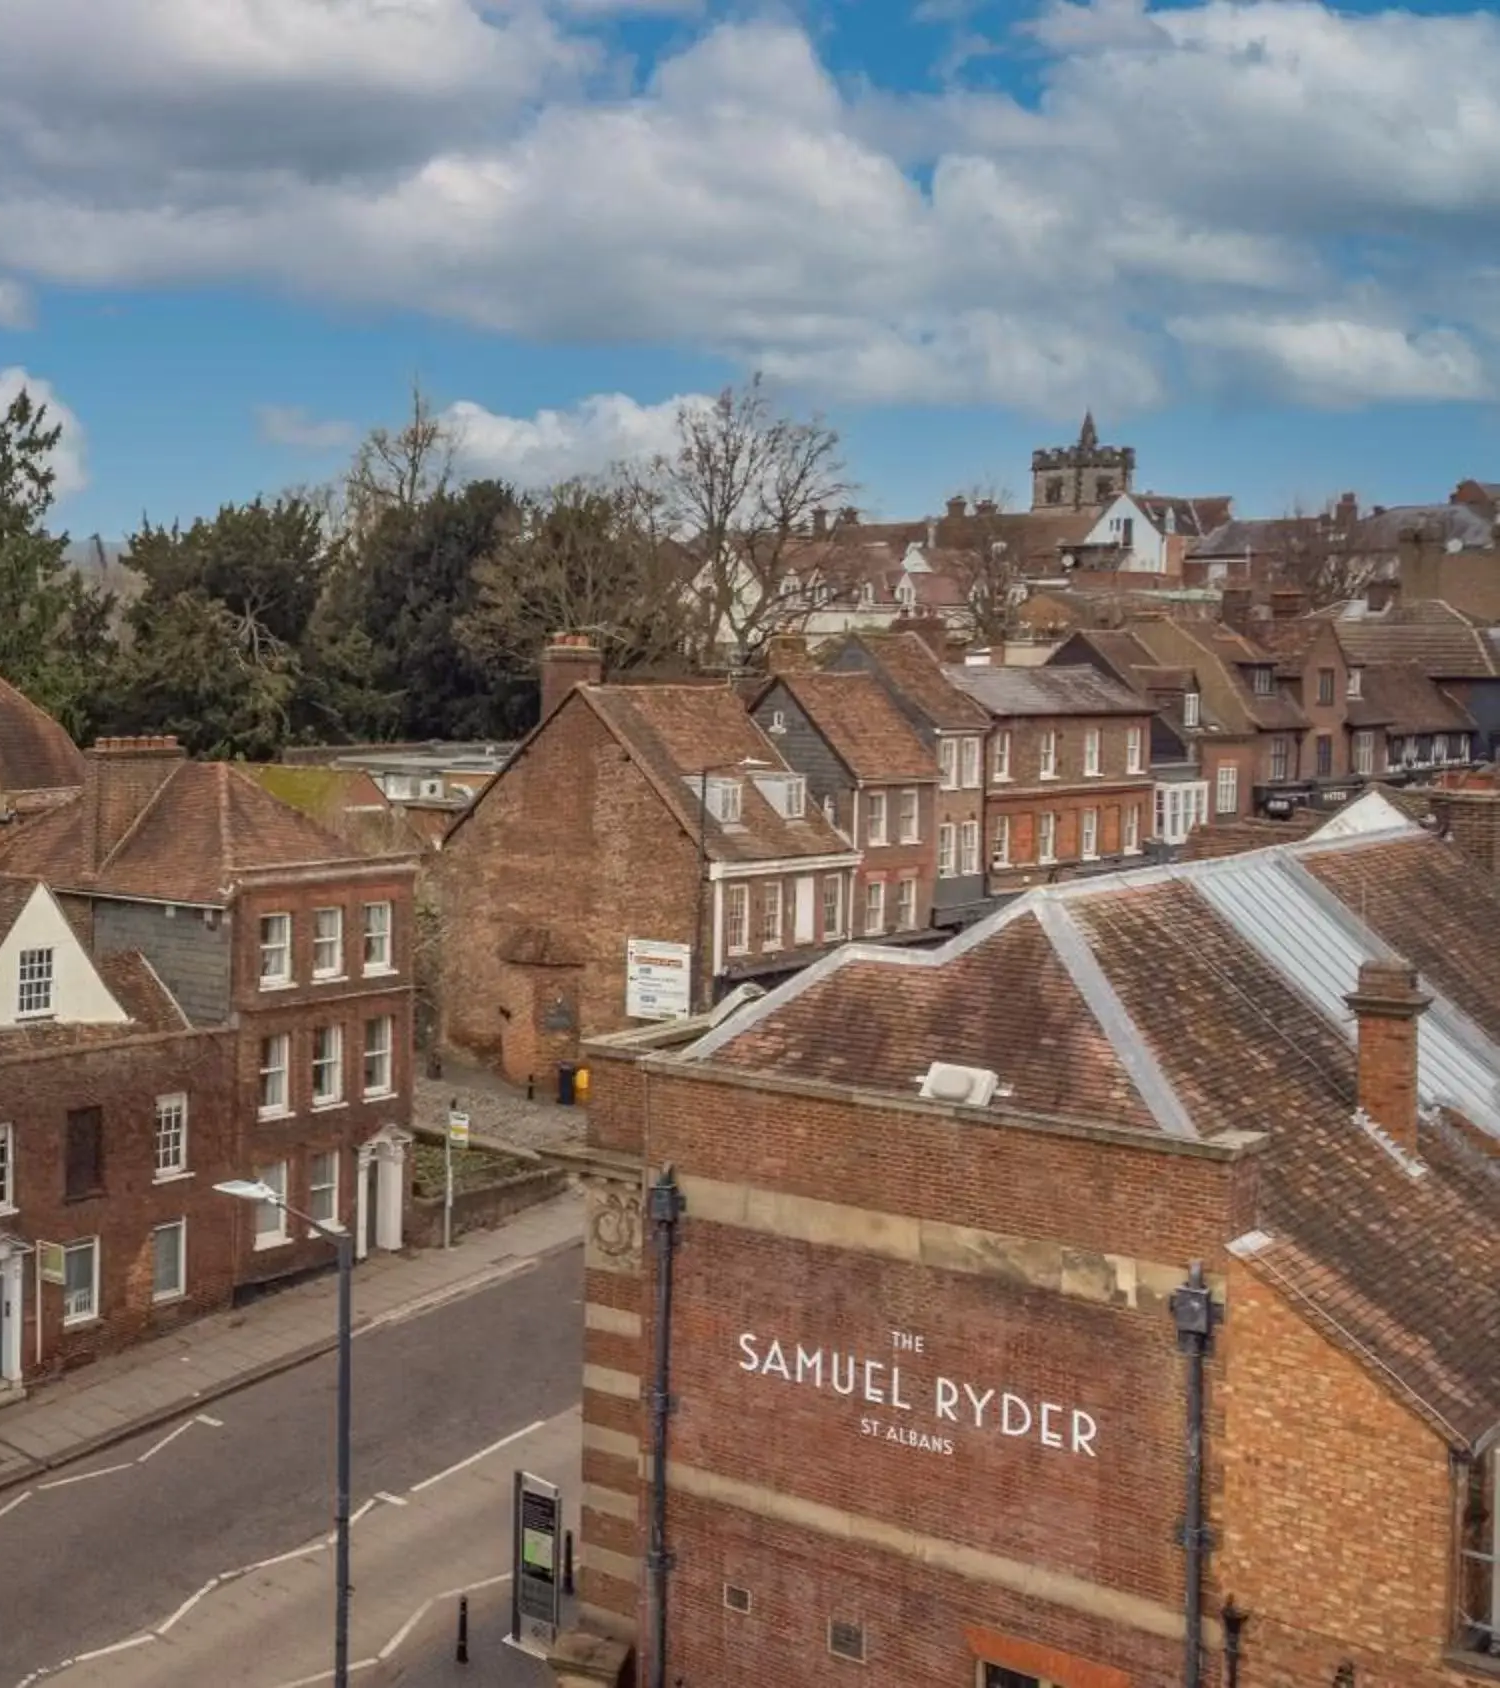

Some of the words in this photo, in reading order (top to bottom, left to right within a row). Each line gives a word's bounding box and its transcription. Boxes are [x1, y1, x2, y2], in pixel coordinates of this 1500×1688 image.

[891, 1330, 924, 1353] THE
[739, 1333, 912, 1410] SAMUEL
[936, 1376, 1097, 1457] RYDER
[861, 1418, 879, 1437] ST
[885, 1426, 953, 1455] ALBANS
